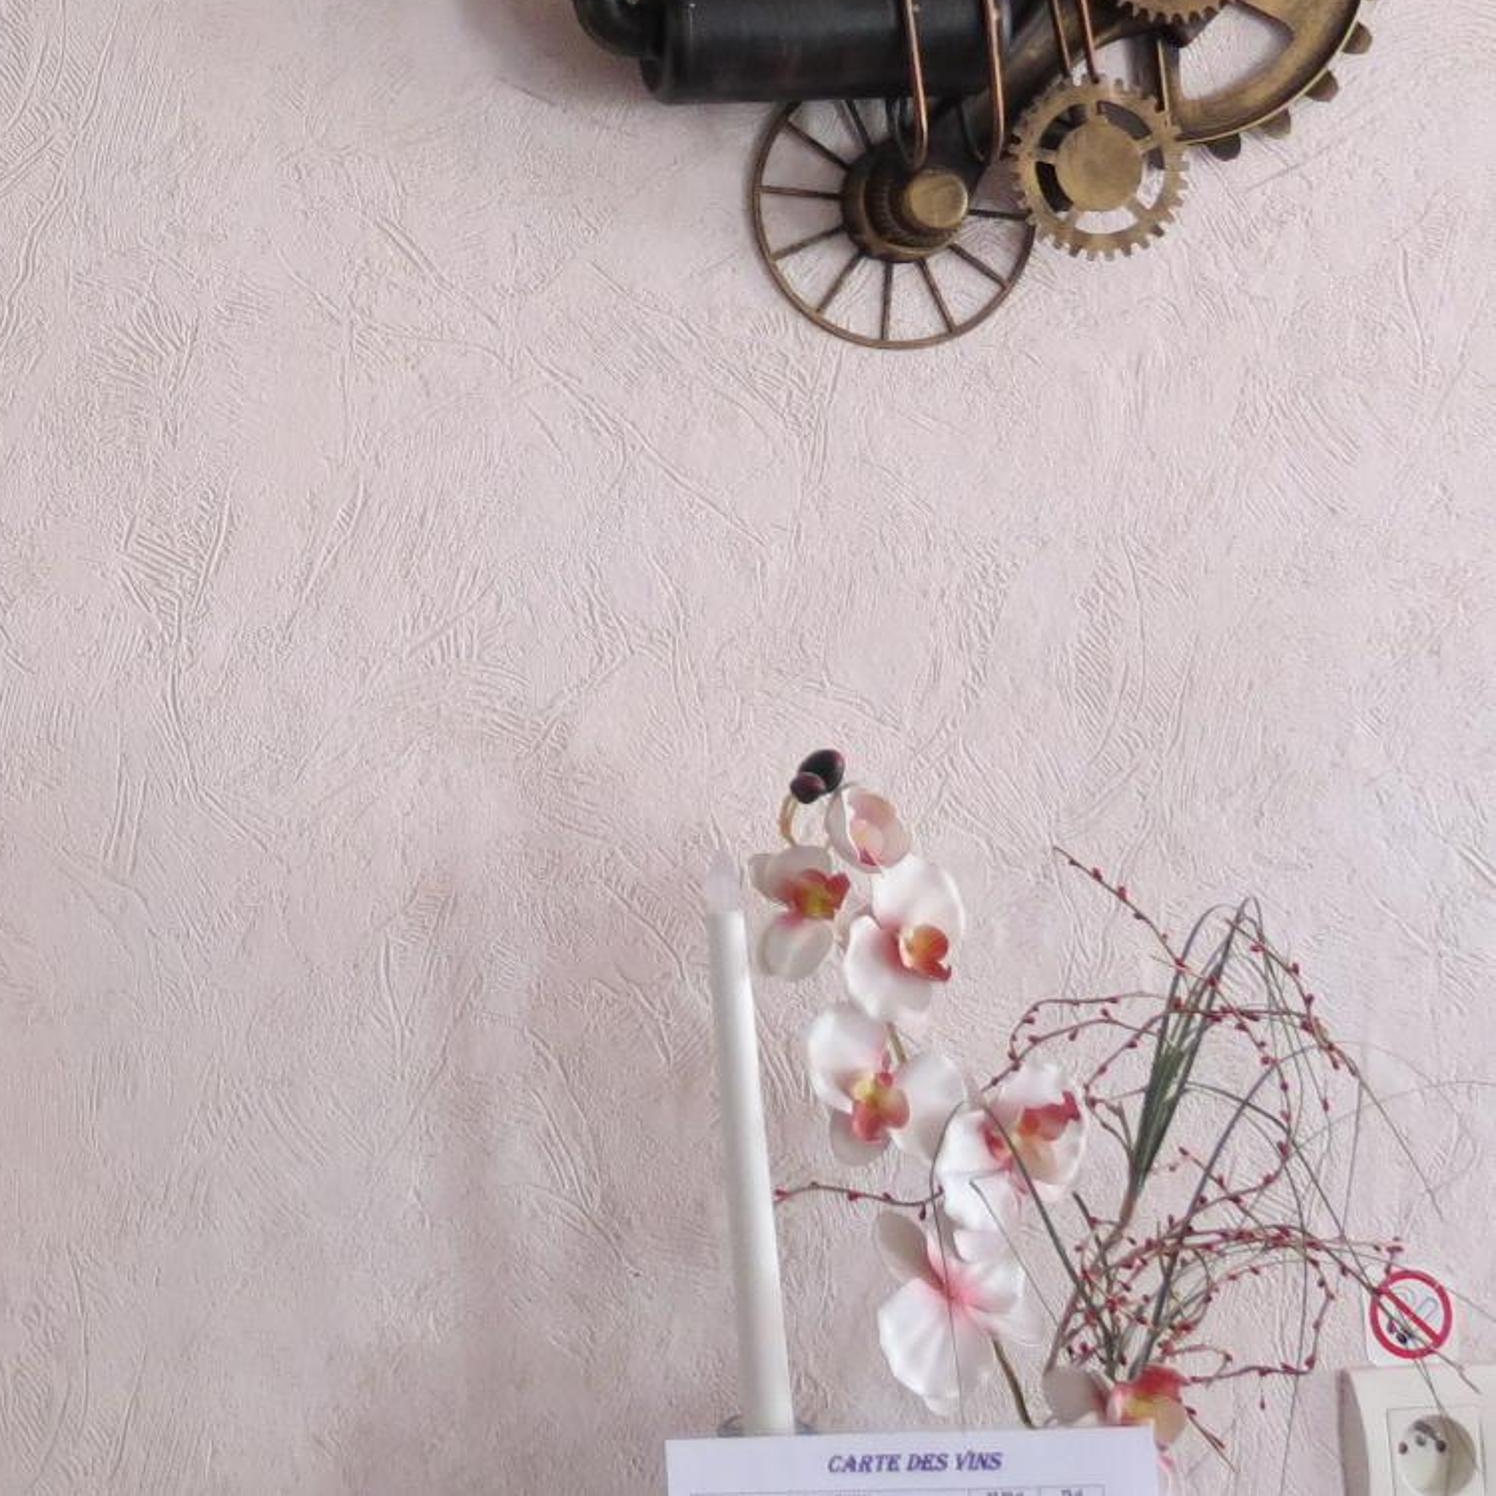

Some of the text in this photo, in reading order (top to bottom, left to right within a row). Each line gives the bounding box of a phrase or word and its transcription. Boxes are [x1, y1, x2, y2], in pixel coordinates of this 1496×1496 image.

[827, 1451, 1003, 1473] CARTE DES VINS
